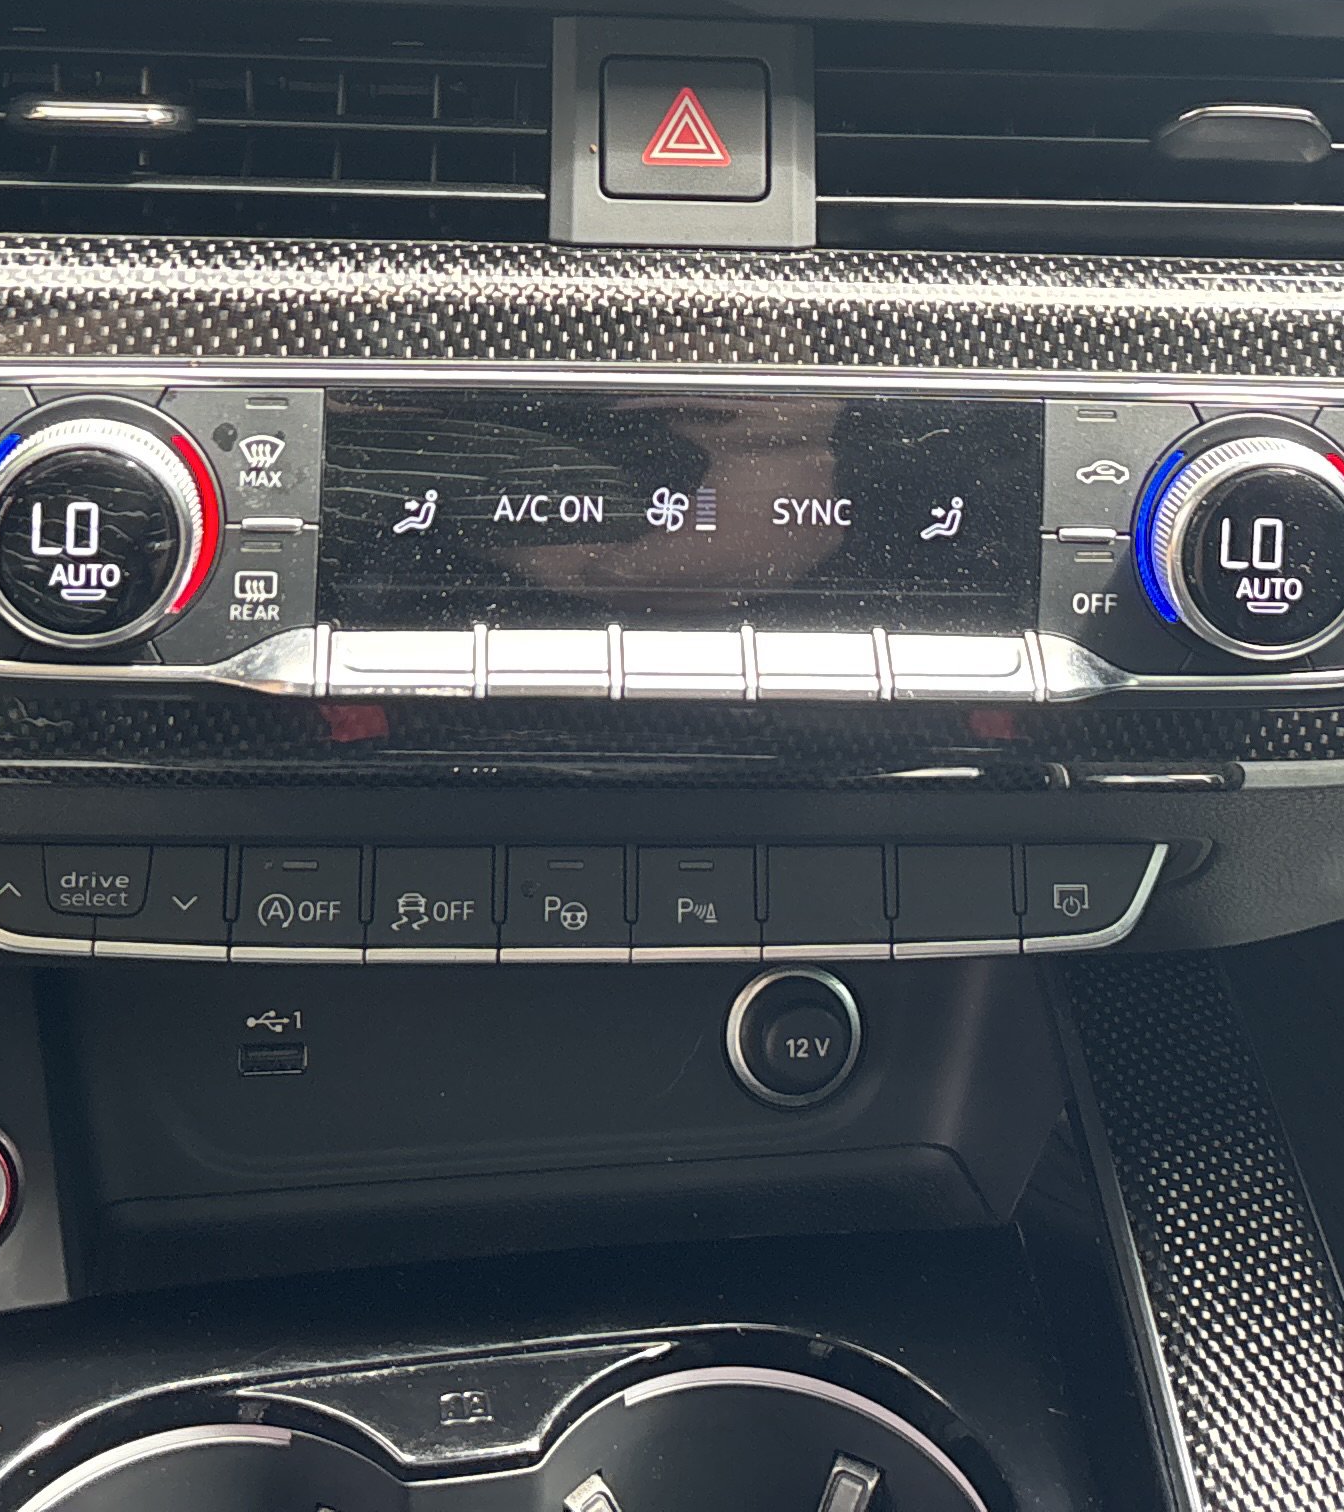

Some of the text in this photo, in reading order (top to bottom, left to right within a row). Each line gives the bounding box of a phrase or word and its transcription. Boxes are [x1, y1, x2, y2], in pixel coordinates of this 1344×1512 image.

[239, 469, 283, 489] MAX
[493, 494, 604, 524] A/C ON
[772, 497, 853, 528] SYNC
[48, 562, 121, 588] AUTO
[1235, 576, 1303, 601] AUTO
[229, 603, 281, 622] REAR
[1072, 592, 1118, 616] OFF
[59, 871, 130, 890] drive
[59, 888, 129, 908] select
[544, 897, 562, 922] P
[298, 900, 341, 923] OFF
[432, 900, 475, 923] OFF
[677, 898, 693, 924] P
[292, 1009, 303, 1030] 1
[785, 1037, 831, 1059] 12 V
